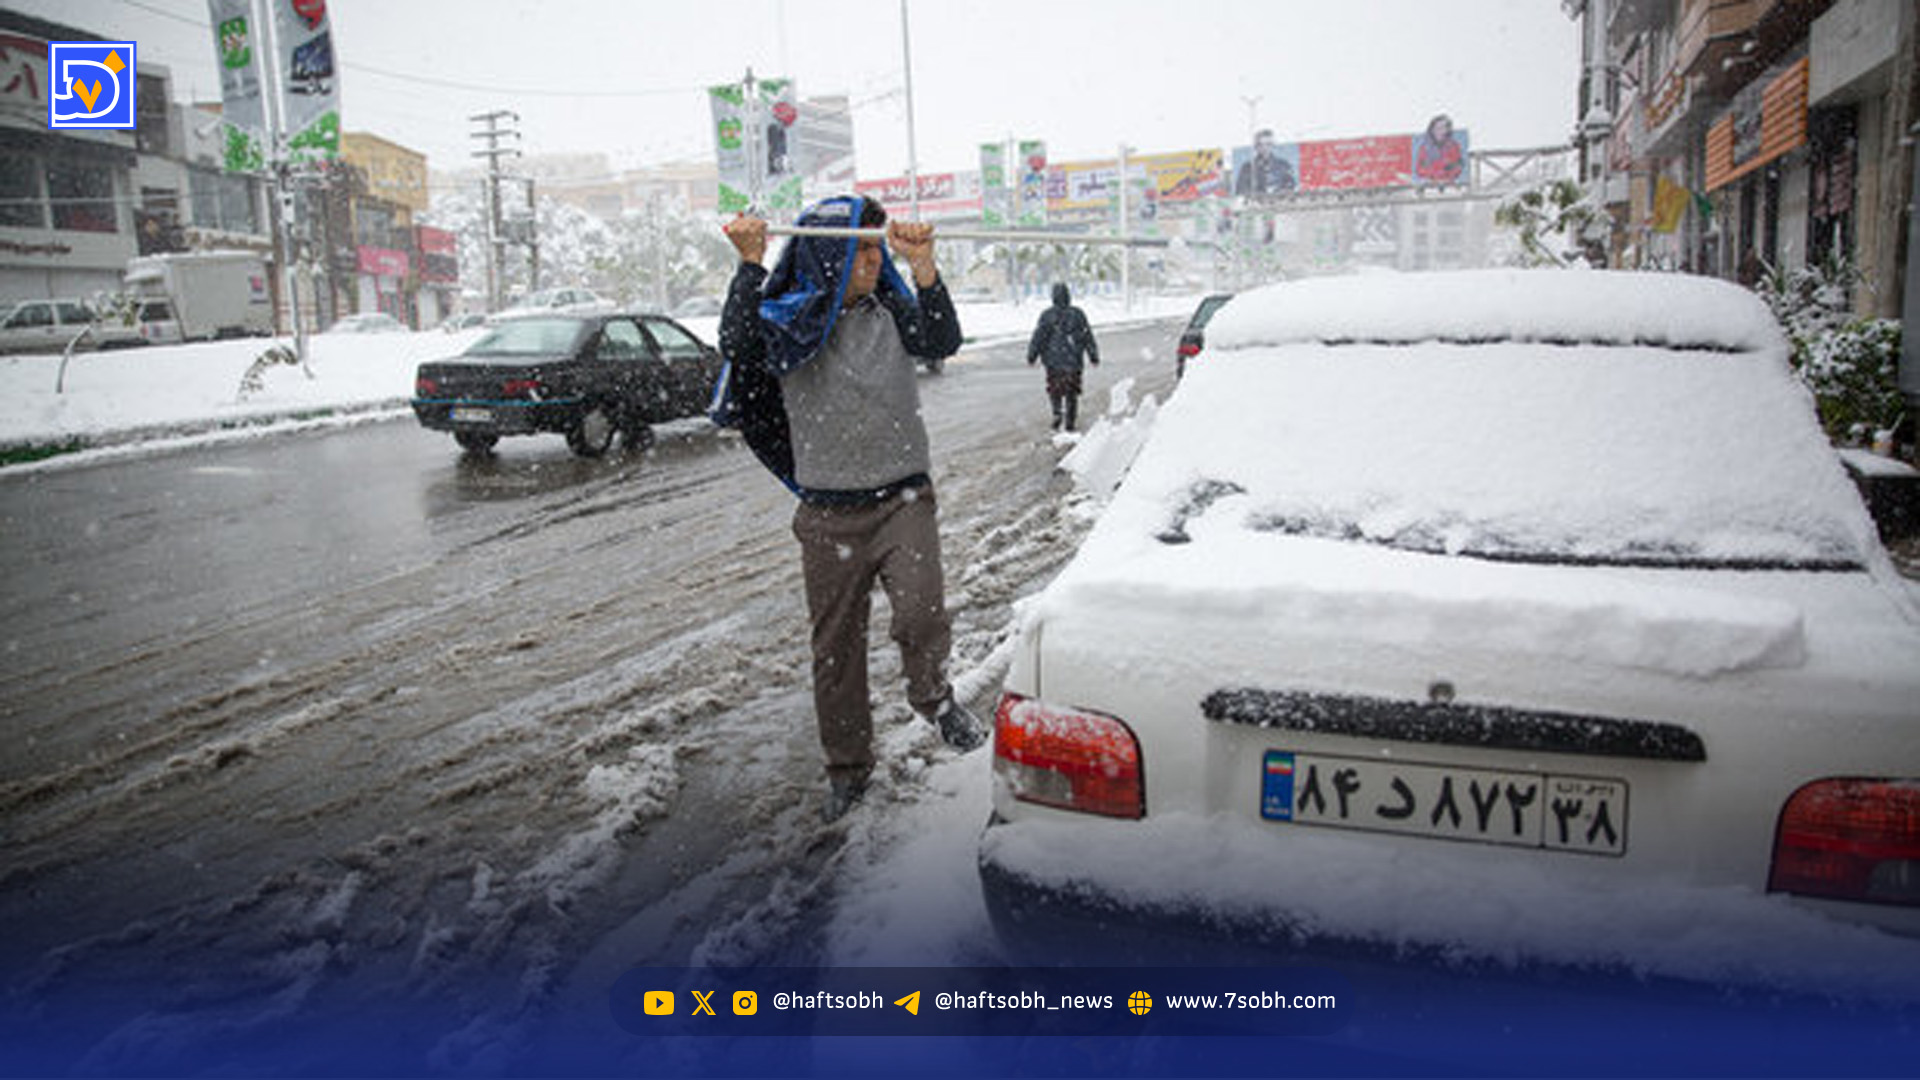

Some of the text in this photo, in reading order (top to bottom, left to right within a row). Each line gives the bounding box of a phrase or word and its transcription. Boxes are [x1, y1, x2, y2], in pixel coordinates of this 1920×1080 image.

[1296, 764, 1618, 847] ۸۴ د ۸۷۲ ۳۸
